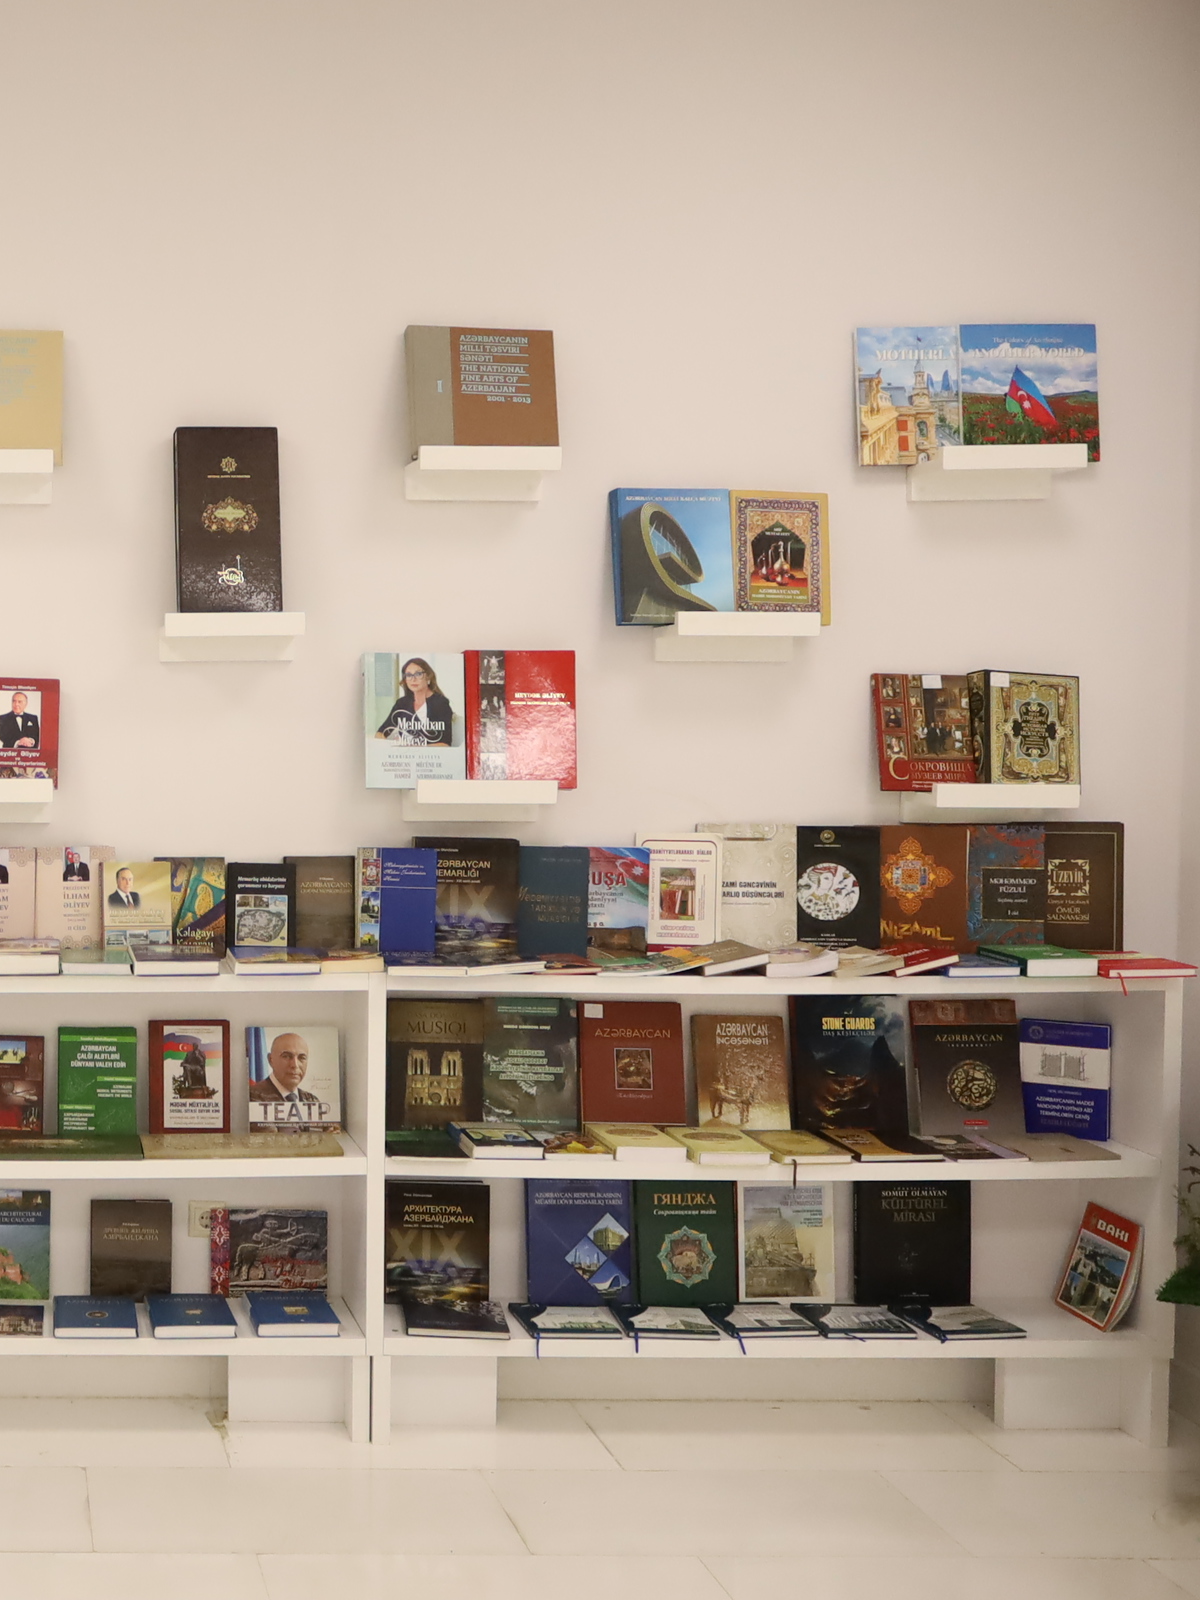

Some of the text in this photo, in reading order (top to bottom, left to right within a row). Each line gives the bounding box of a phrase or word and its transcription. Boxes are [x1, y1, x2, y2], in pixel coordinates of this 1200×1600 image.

[460, 335, 528, 344] AZƏRBAYCANIN
[460, 354, 493, 362] SƏNƏTİ
[480, 365, 526, 373] NATIONAL
[461, 385, 516, 393] AZERBAIJAN
[437, 860, 490, 868] ZƏRBAYCAN
[436, 869, 479, 877] EMARLIĞI
[1053, 868, 1084, 883] ÜZEYİR
[592, 872, 627, 890] UŞA
[177, 926, 214, 939] Kəlağayı
[716, 1023, 769, 1036] AZƏRBAYCAN
[822, 1018, 875, 1030] STONE GUARDS
[595, 1028, 671, 1039] AZƏRBAYCAN
[935, 1034, 1003, 1042] AZƏRBAYCAN
[716, 1036, 769, 1045] İNCƏSƏNƏTİ
[259, 1102, 331, 1121] ТЕАТР
[654, 1193, 716, 1206] ГЯНДЖА
[881, 1198, 948, 1210] KÜLTÜREL
[404, 1204, 463, 1214] АРХИТЕКТУРА
[404, 1213, 474, 1223] АЗЕРБАЙДЖАНА
[894, 1211, 936, 1222] MİRASI
[1096, 1219, 1130, 1242] BAKI
